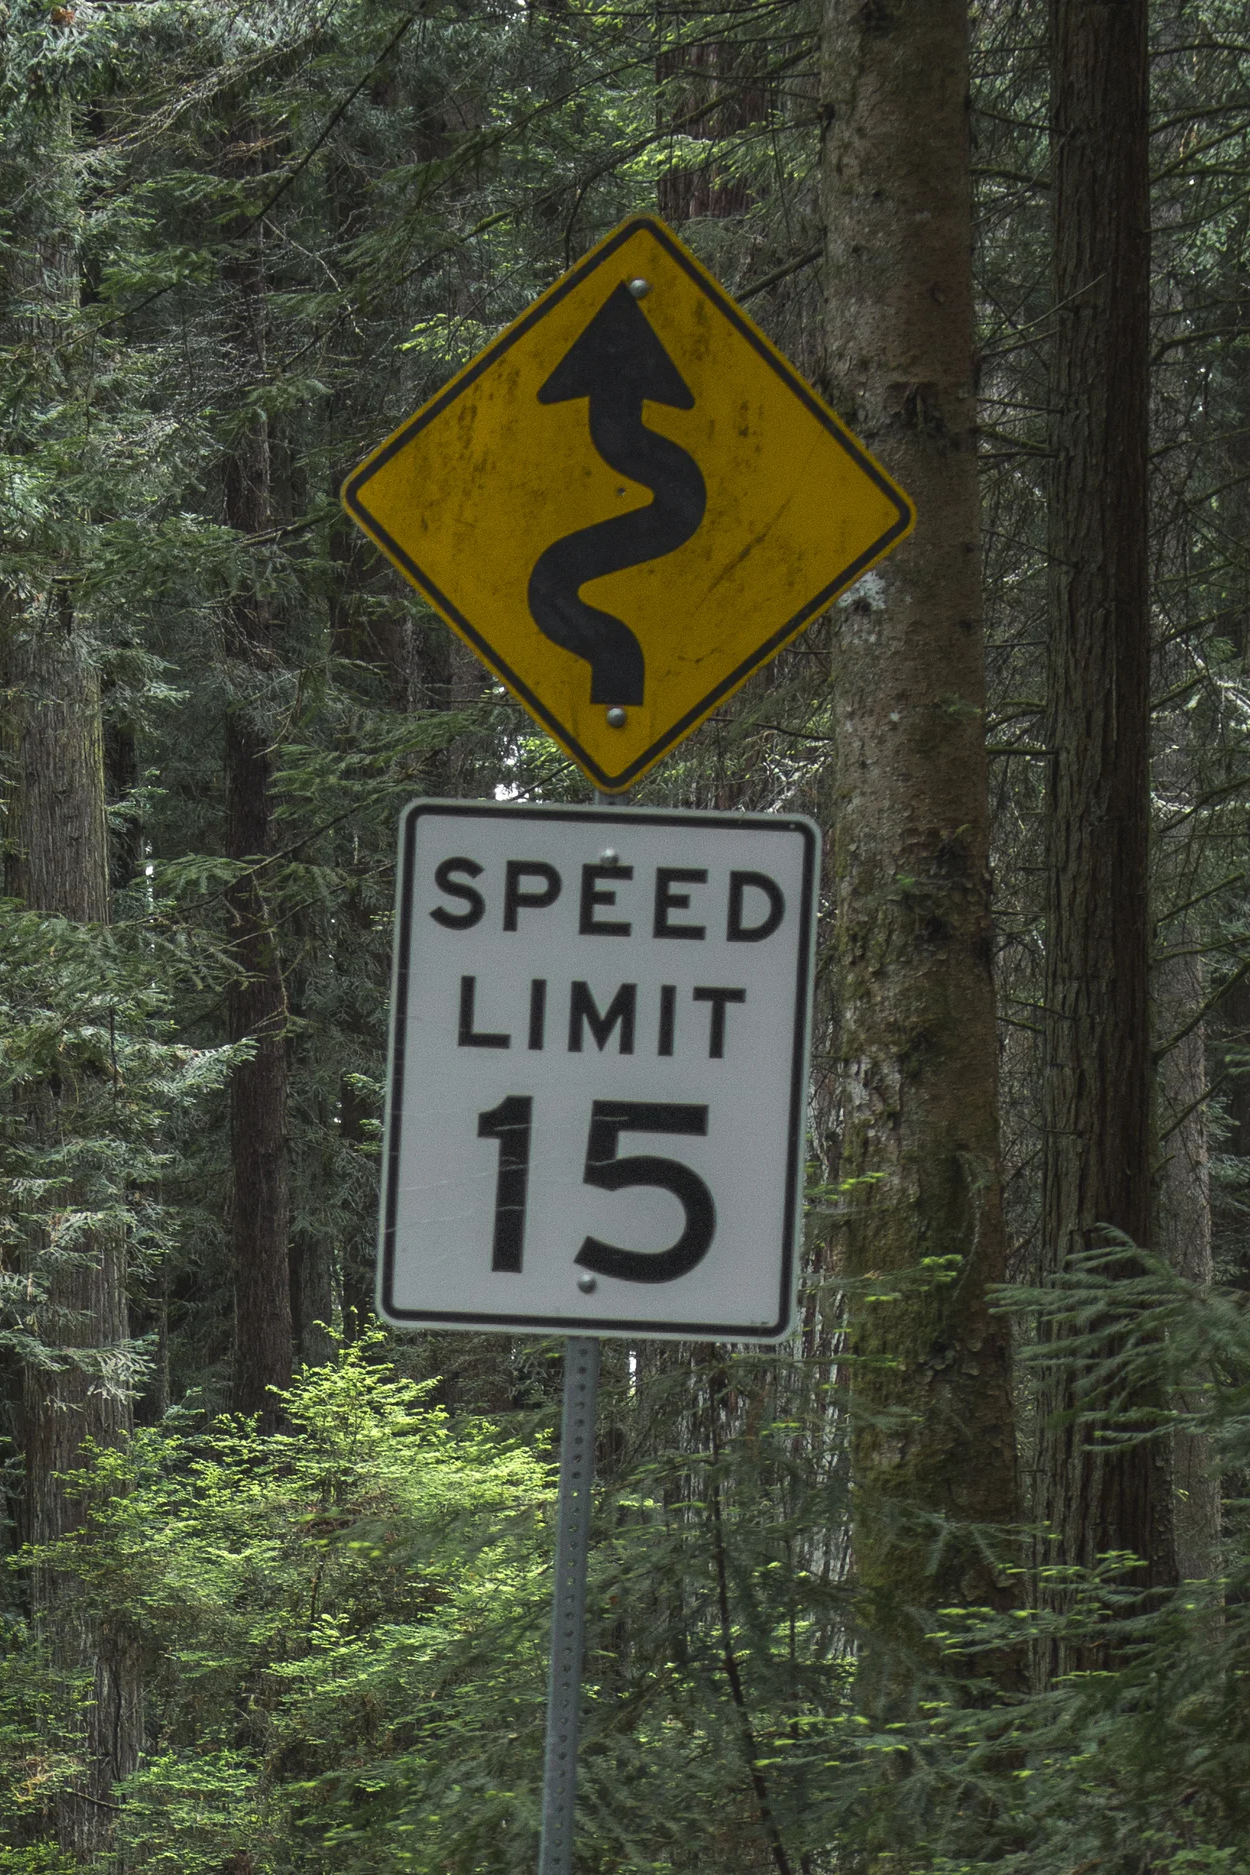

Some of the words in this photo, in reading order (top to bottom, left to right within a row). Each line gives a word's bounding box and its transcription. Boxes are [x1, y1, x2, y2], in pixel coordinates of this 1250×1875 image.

[428, 856, 787, 943] SPEED
[457, 975, 747, 1060] LIMIT
[477, 1095, 717, 1285] 15
